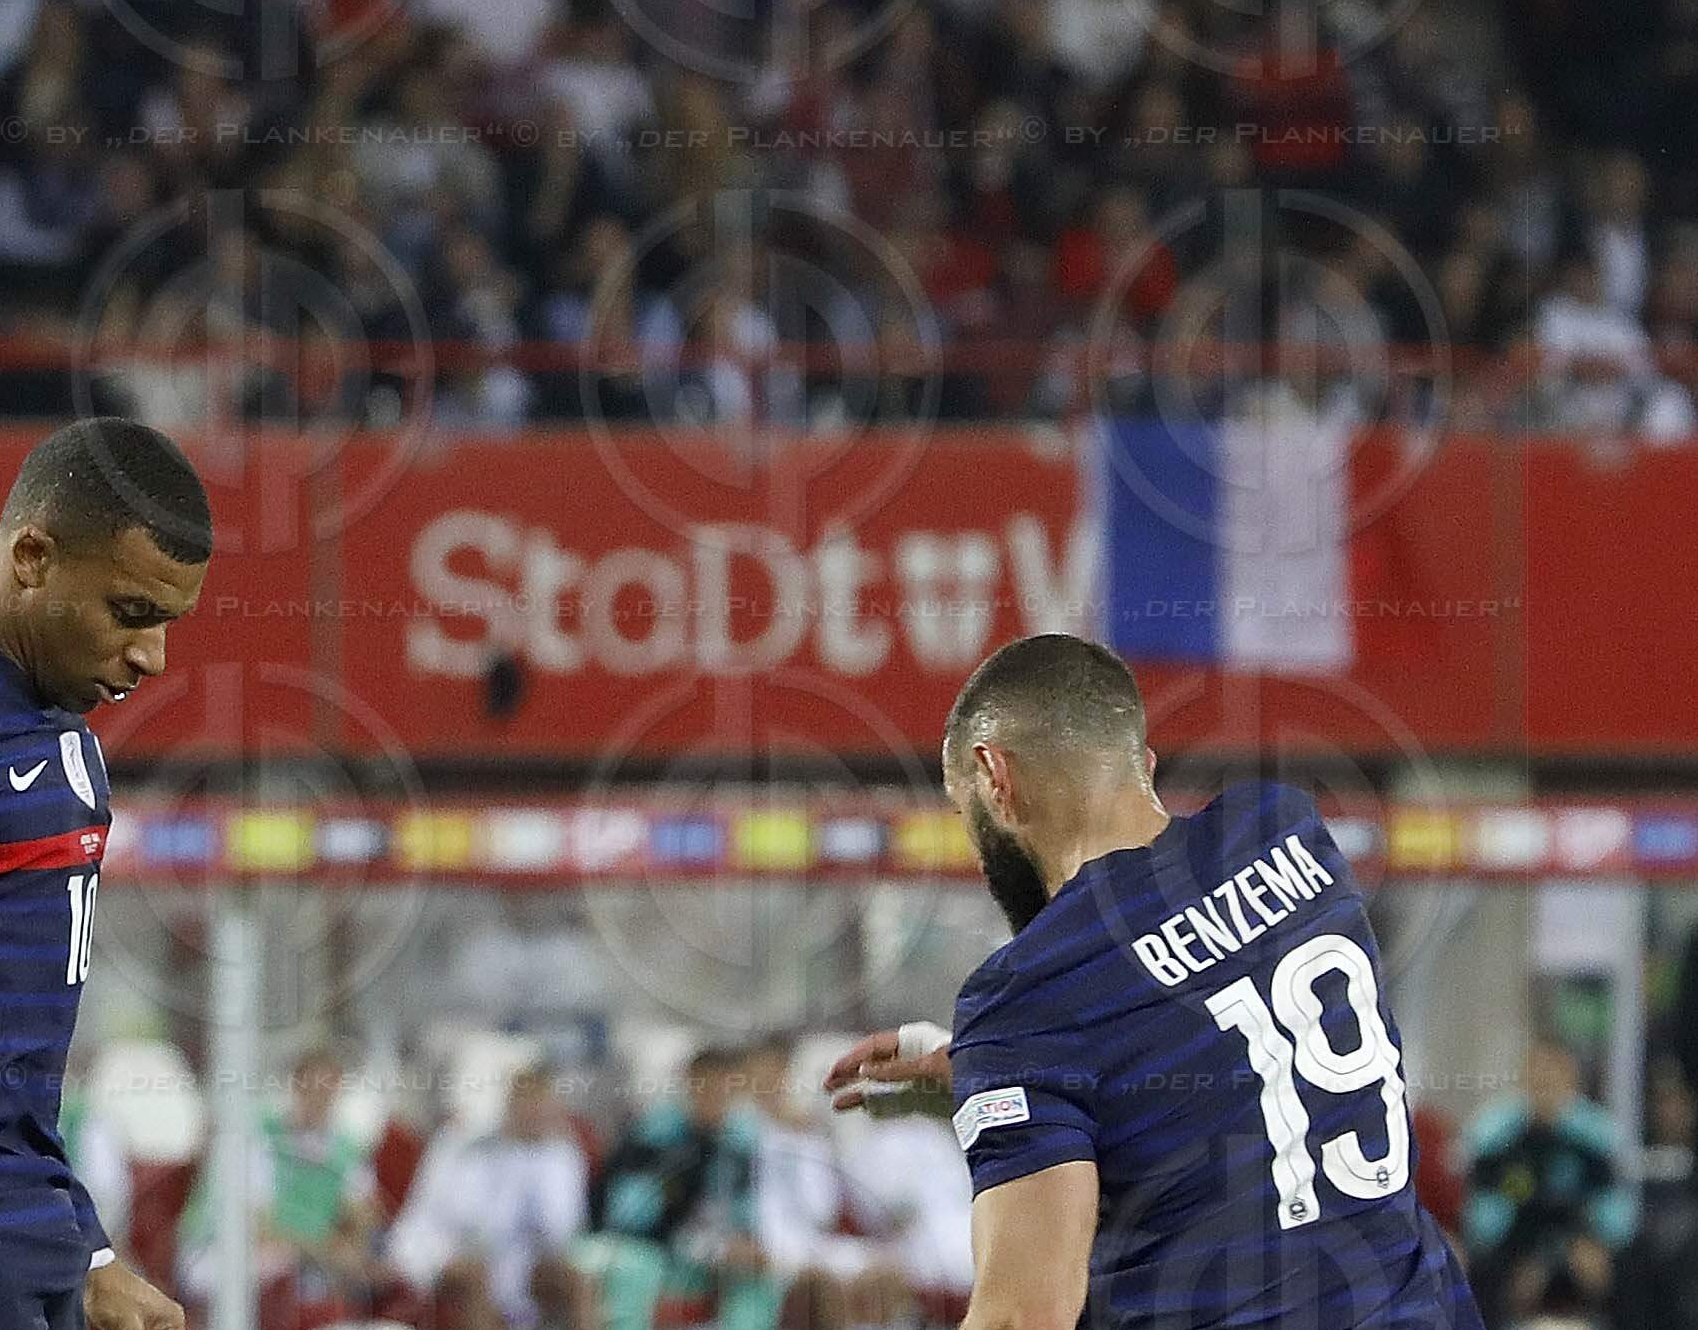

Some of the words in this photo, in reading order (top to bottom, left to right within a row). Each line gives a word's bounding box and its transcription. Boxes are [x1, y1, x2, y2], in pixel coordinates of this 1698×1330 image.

[66, 873, 99, 985] 10
[1131, 834, 1334, 987] BENZEMA
[1204, 934, 1410, 1230] 19
